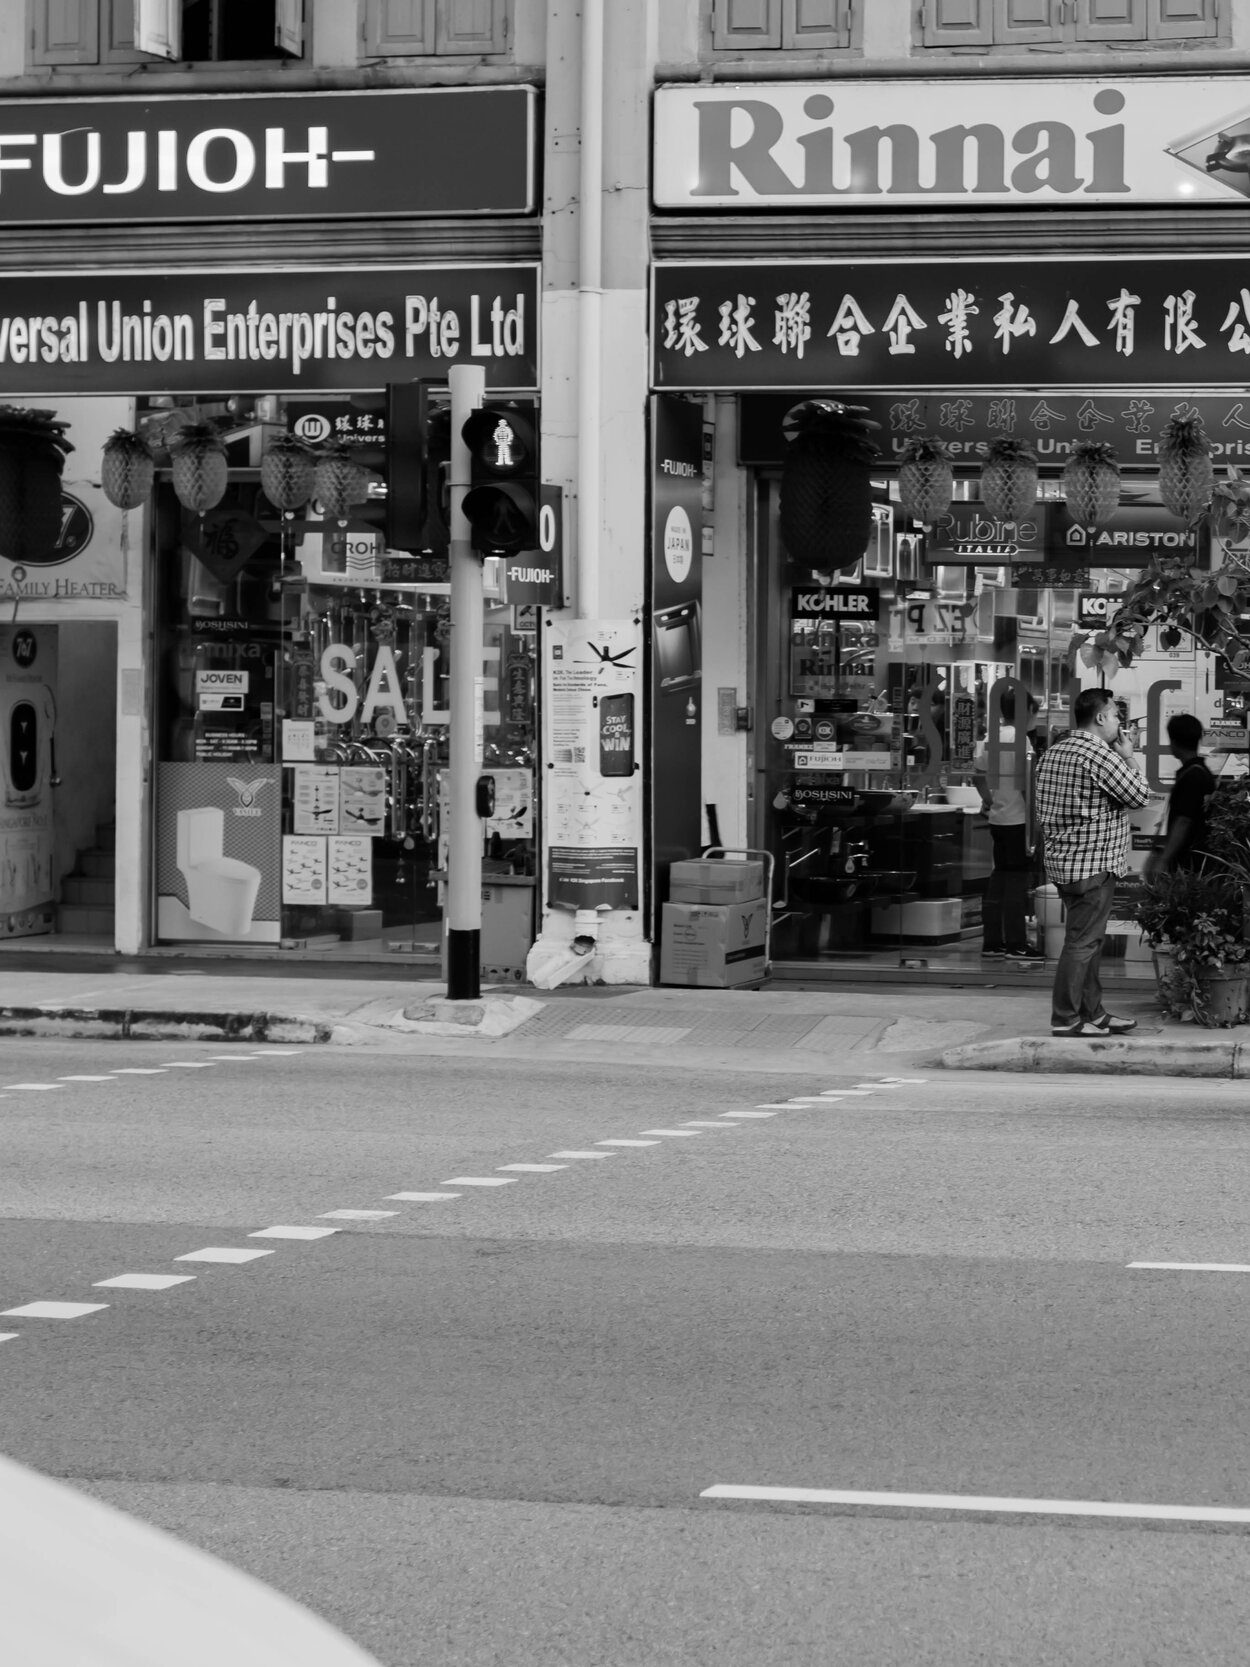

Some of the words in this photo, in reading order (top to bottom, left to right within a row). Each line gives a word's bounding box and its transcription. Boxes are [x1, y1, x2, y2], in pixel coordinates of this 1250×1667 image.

[689, 94, 1131, 197] Rinnai
[97, 300, 195, 363] Union
[203, 296, 395, 374] Enterprises
[404, 294, 460, 358] Pte
[469, 293, 525, 357] Ltd
[1095, 531, 1195, 547] ARISTON
[797, 594, 870, 612] KOHLER
[201, 674, 242, 683] JOVEN
[606, 715, 626, 724] STAY
[603, 723, 628, 735] COOL
[794, 789, 852, 801] BOSHSINI
